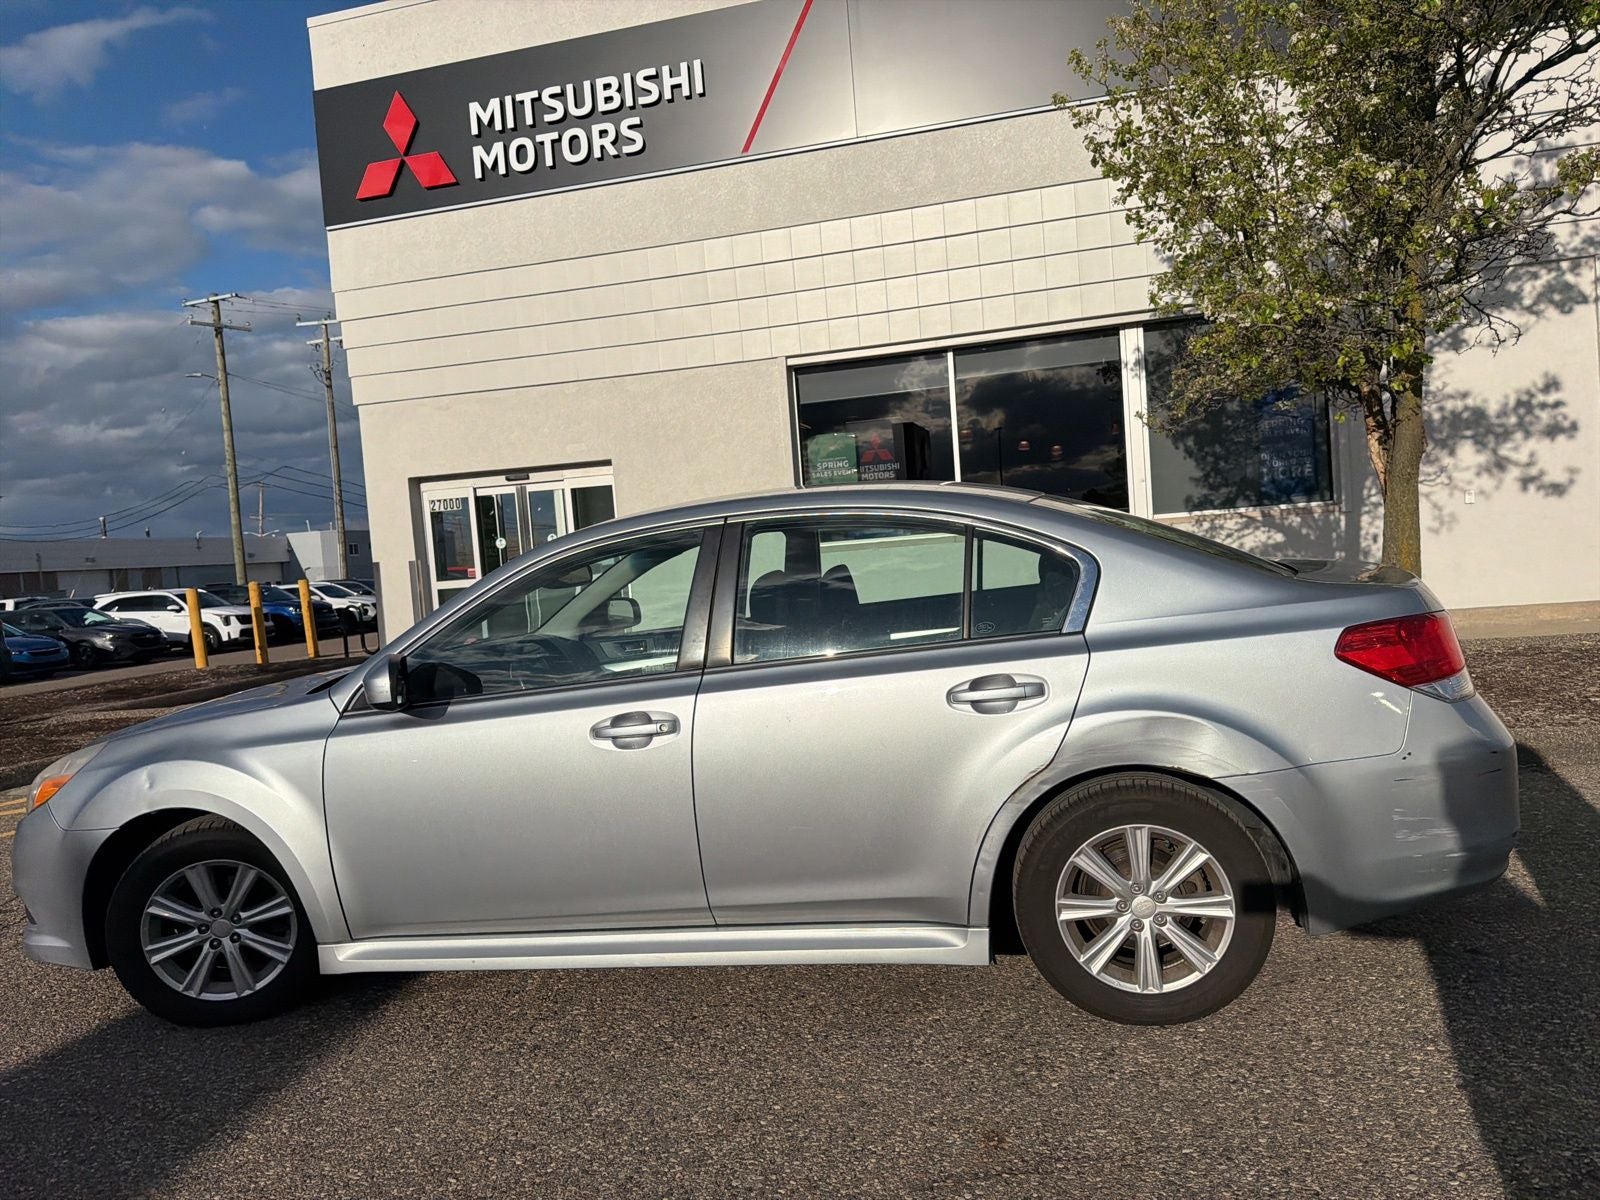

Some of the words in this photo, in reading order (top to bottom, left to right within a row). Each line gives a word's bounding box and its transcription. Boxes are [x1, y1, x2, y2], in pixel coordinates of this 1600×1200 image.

[468, 59, 705, 137] MITSUBISHI
[472, 117, 645, 180] MOTORS
[817, 460, 849, 470] SPRING
[812, 470, 833, 478] SALES
[861, 471, 895, 480] MOTORS
[430, 498, 461, 511] 27000
